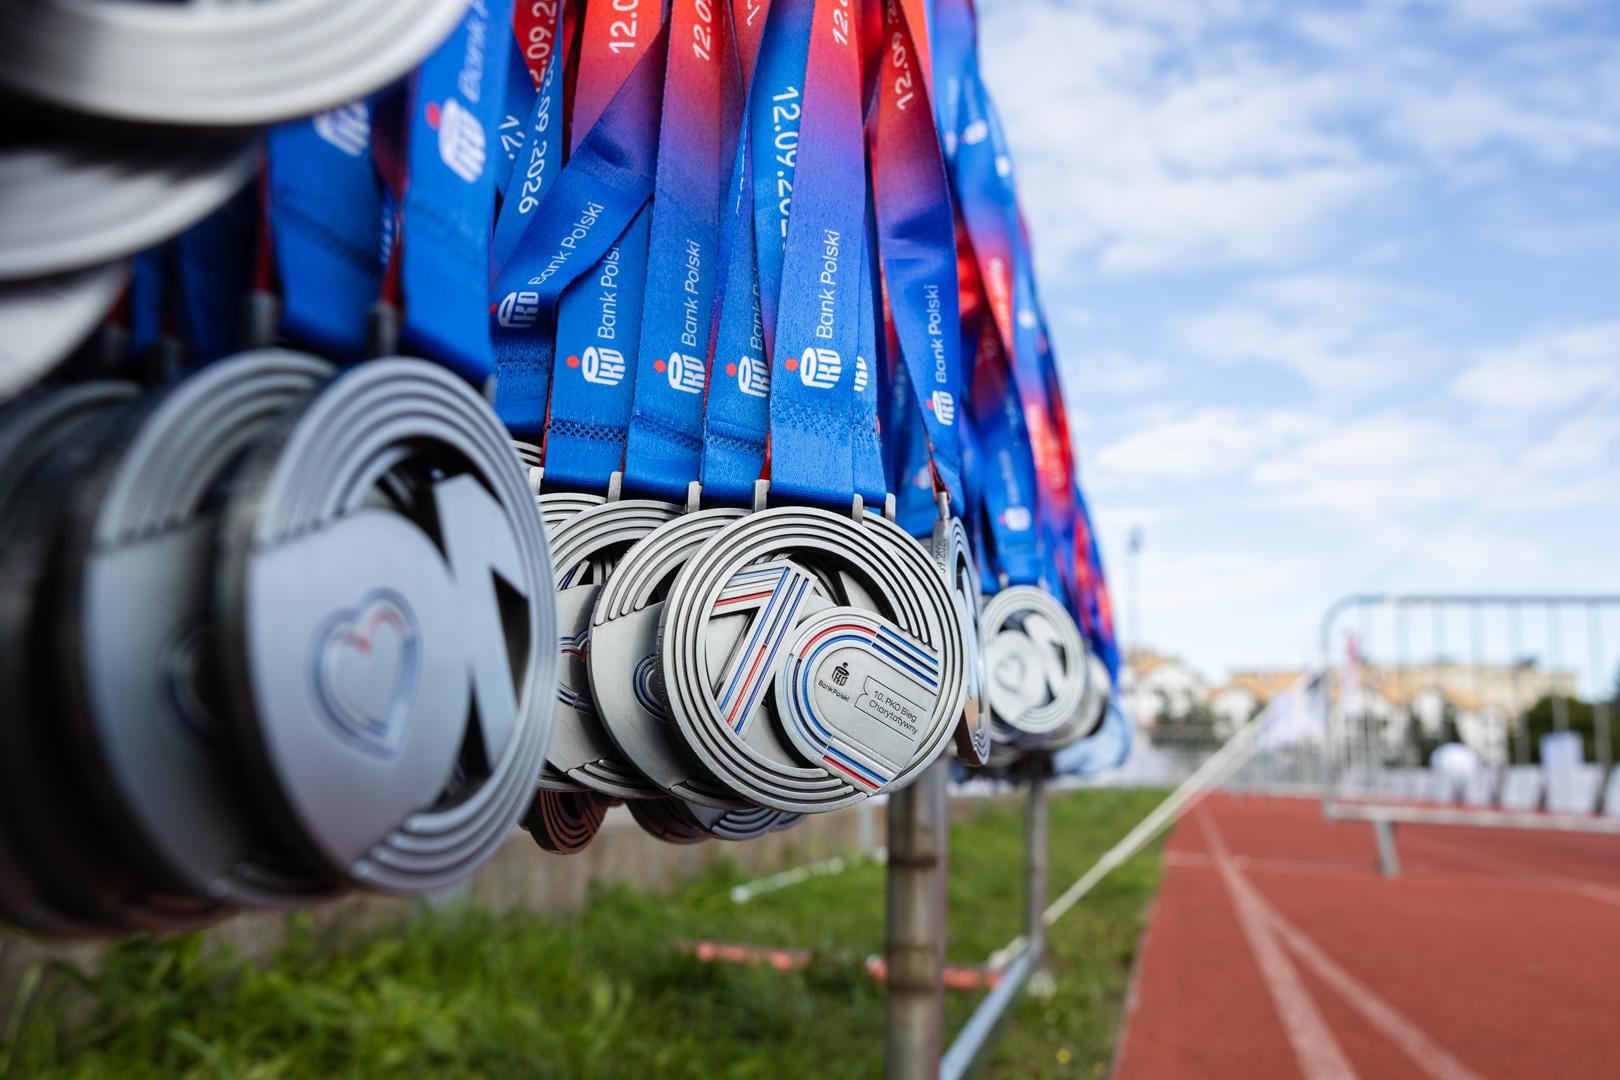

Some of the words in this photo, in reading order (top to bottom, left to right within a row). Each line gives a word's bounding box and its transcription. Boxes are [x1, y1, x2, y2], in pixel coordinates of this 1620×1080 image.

[527, 250, 572, 285] Bank
[560, 201, 605, 249] Polski
[600, 242, 620, 288] Pols
[684, 239, 701, 295] Polski
[820, 229, 841, 285] Polski
[597, 291, 618, 339] Bank
[681, 297, 699, 347] Bank
[816, 288, 835, 339] Bank
[924, 285, 943, 335] Polski
[934, 339, 948, 383] Bank
[818, 679, 834, 693] Bank
[832, 688, 850, 702] Polski
[874, 690, 884, 703] 10.
[885, 697, 901, 712] PKO
[900, 706, 918, 723] Bieg
[868, 699, 919, 735] Charytatywny
